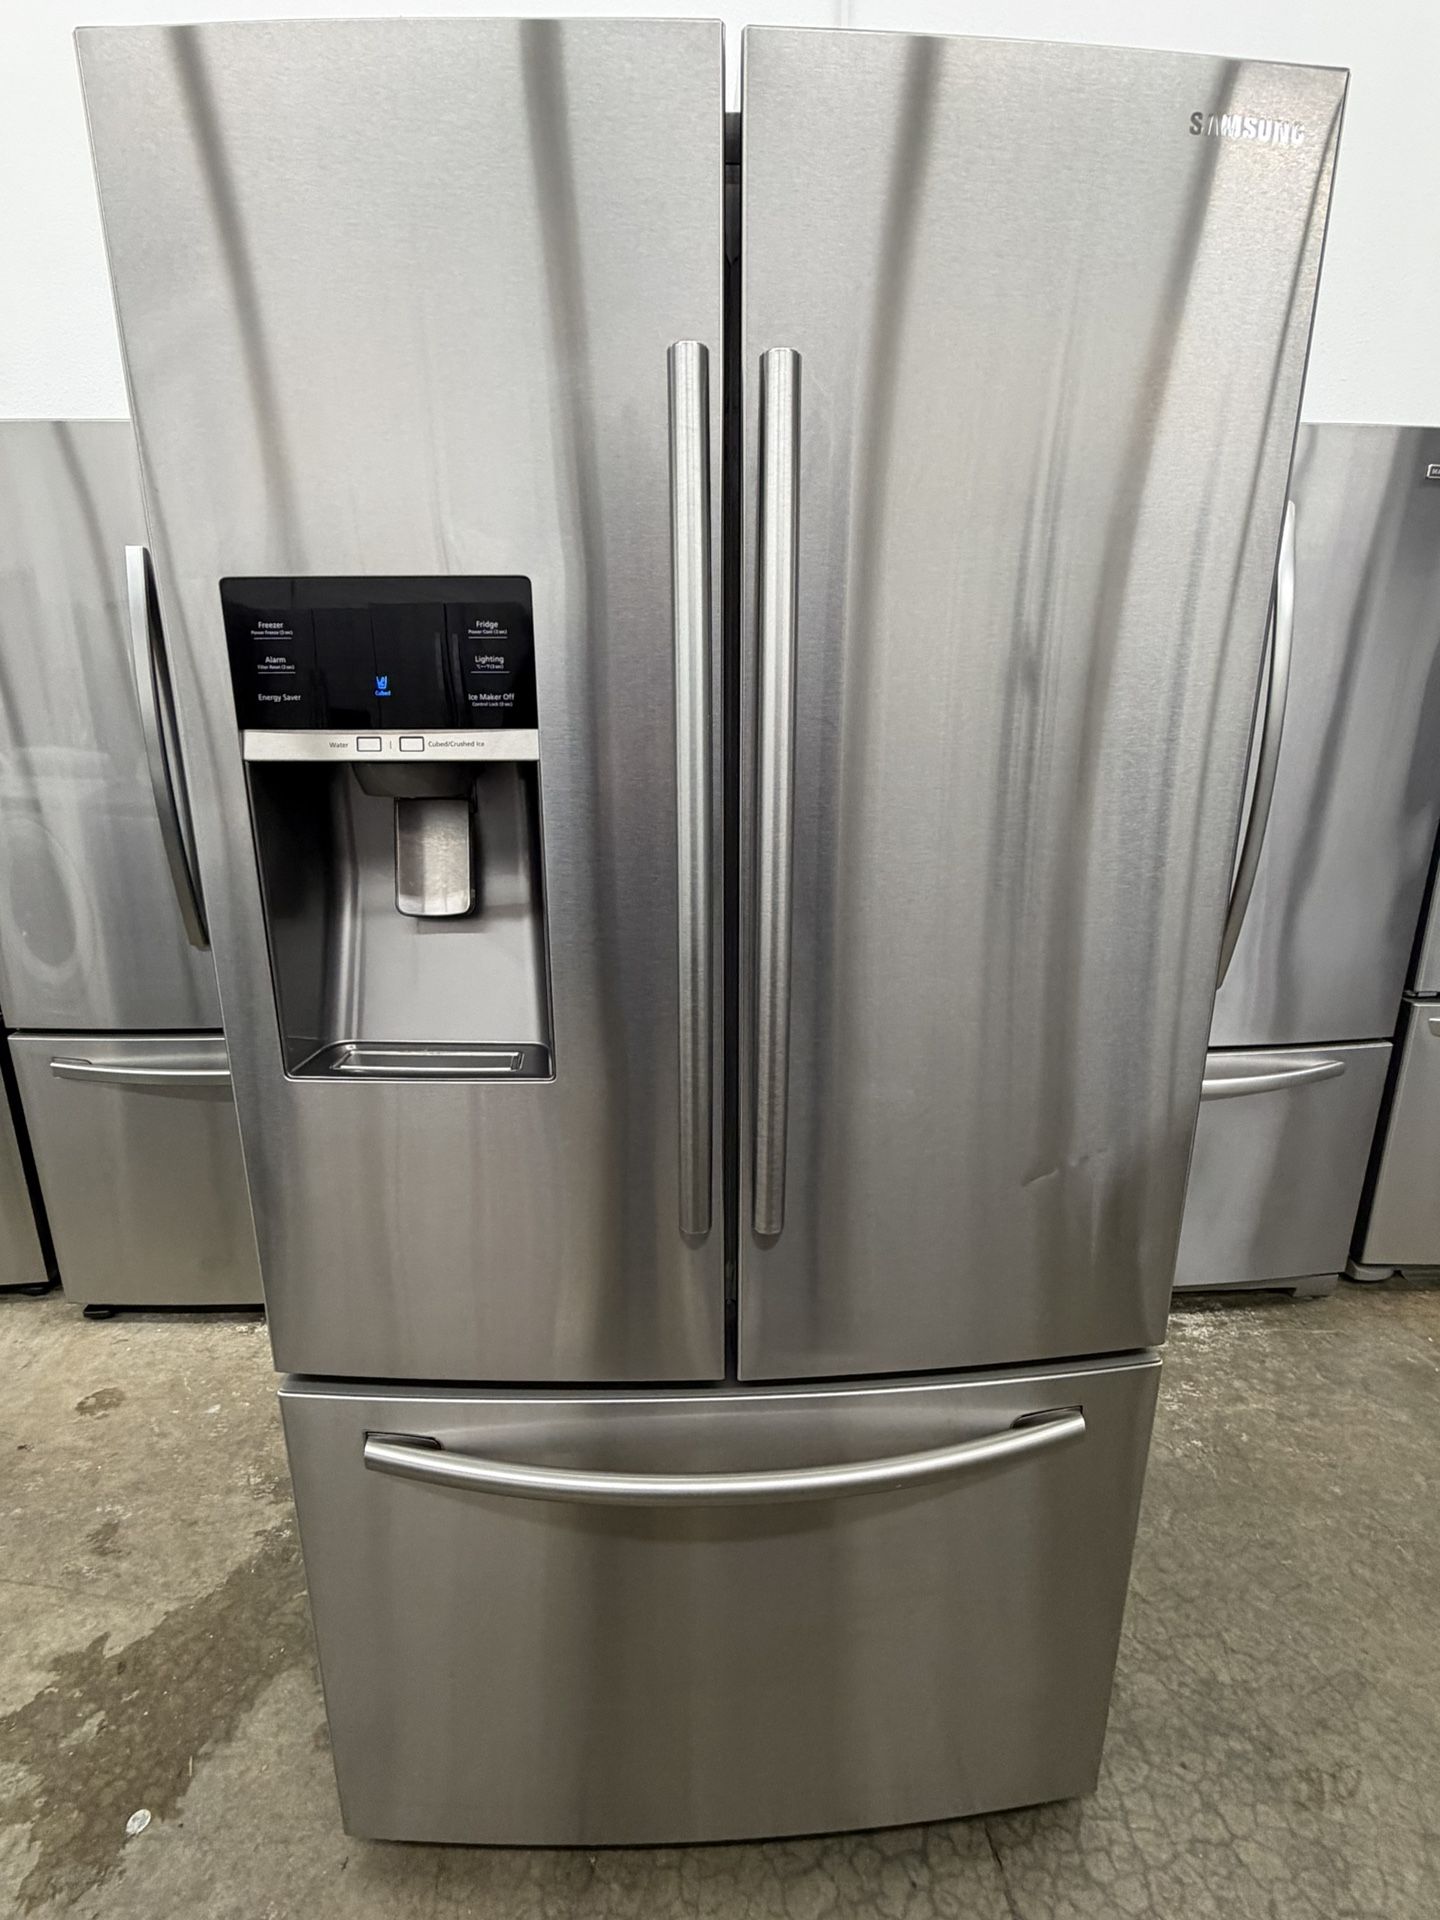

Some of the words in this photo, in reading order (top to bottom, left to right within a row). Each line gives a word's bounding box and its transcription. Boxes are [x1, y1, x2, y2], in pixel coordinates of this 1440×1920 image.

[1189, 111, 1306, 145] SAMSUNG
[476, 620, 498, 629] Fridge
[474, 655, 504, 664] Lighting
[258, 694, 281, 702] Energy
[282, 693, 301, 701] Saver
[467, 693, 479, 701] Ice
[479, 692, 502, 701] Maker
[502, 692, 515, 701] Off
